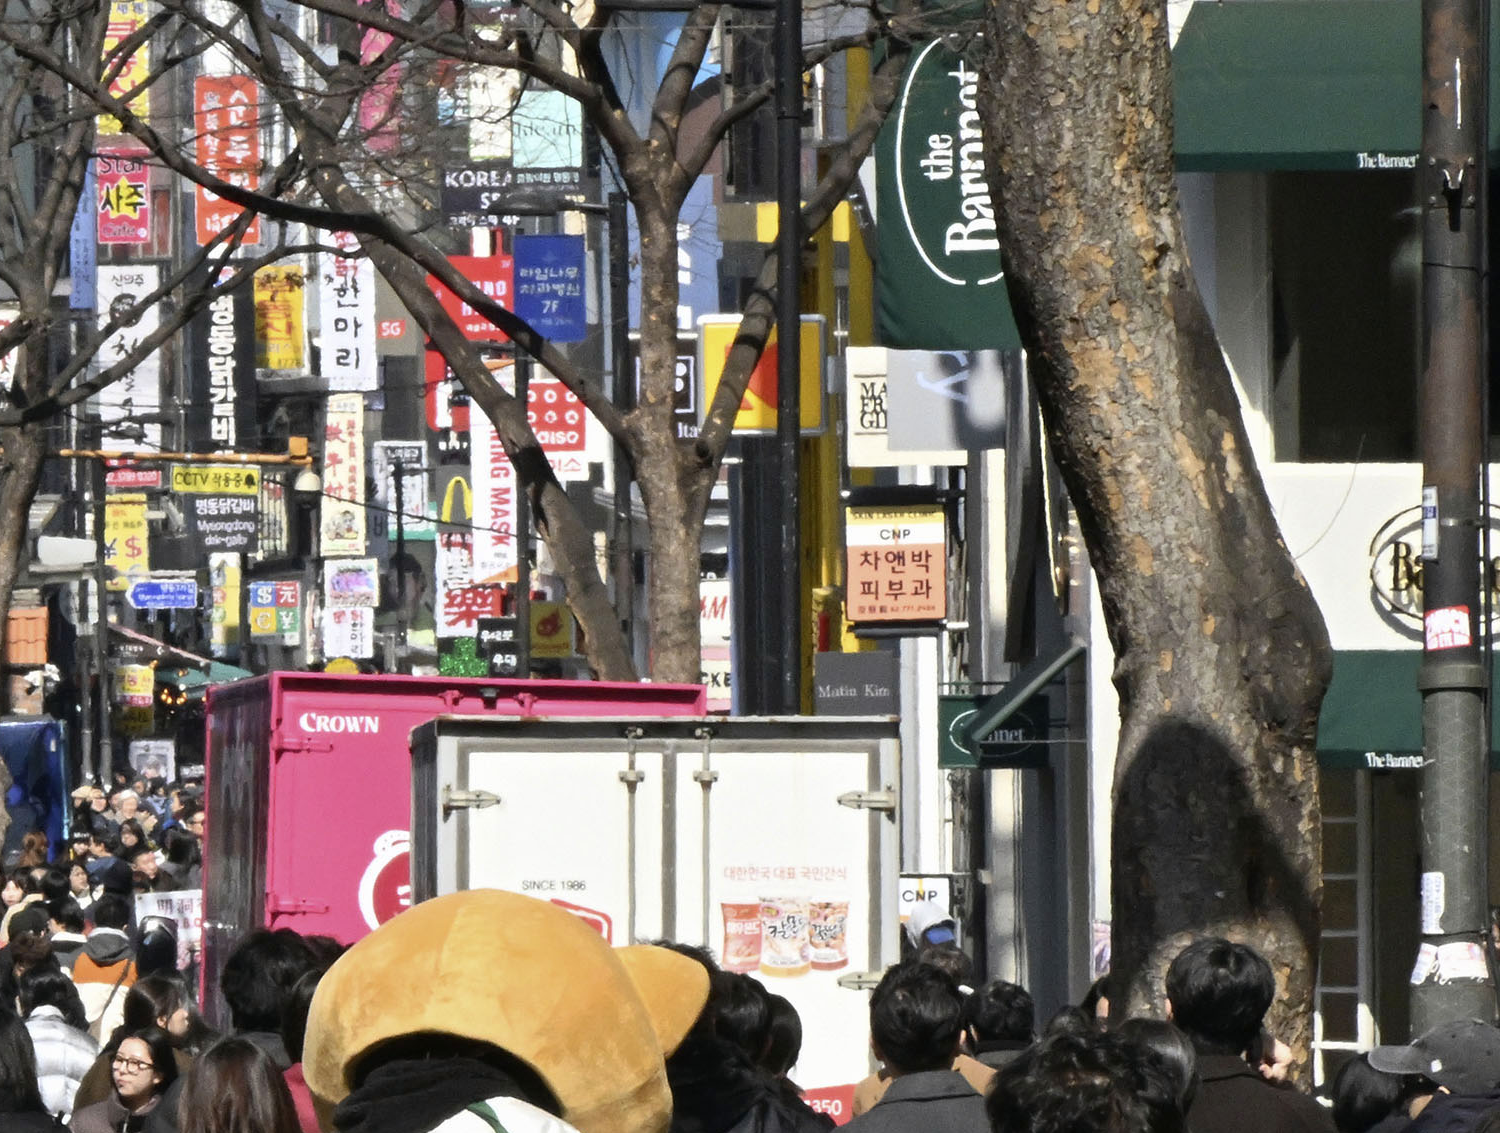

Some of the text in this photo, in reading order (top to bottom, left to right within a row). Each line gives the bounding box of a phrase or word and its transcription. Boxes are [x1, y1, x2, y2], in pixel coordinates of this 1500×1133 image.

[920, 133, 954, 181] the
[101, 183, 145, 213] 사주
[381, 322, 401, 336] 5G
[174, 472, 209, 487] CCTV
[490, 487, 511, 547] MASK
[879, 529, 911, 541] CNP
[125, 534, 143, 560] $
[859, 549, 933, 574] 차앤박
[279, 585, 296, 603] 元
[859, 579, 933, 601] 피부과
[864, 683, 890, 697] Kim
[299, 713, 379, 734] CROWN
[723, 865, 771, 881] 대한민국
[522, 880, 587, 891] SINCE 1986
[902, 889, 938, 903] CNP
